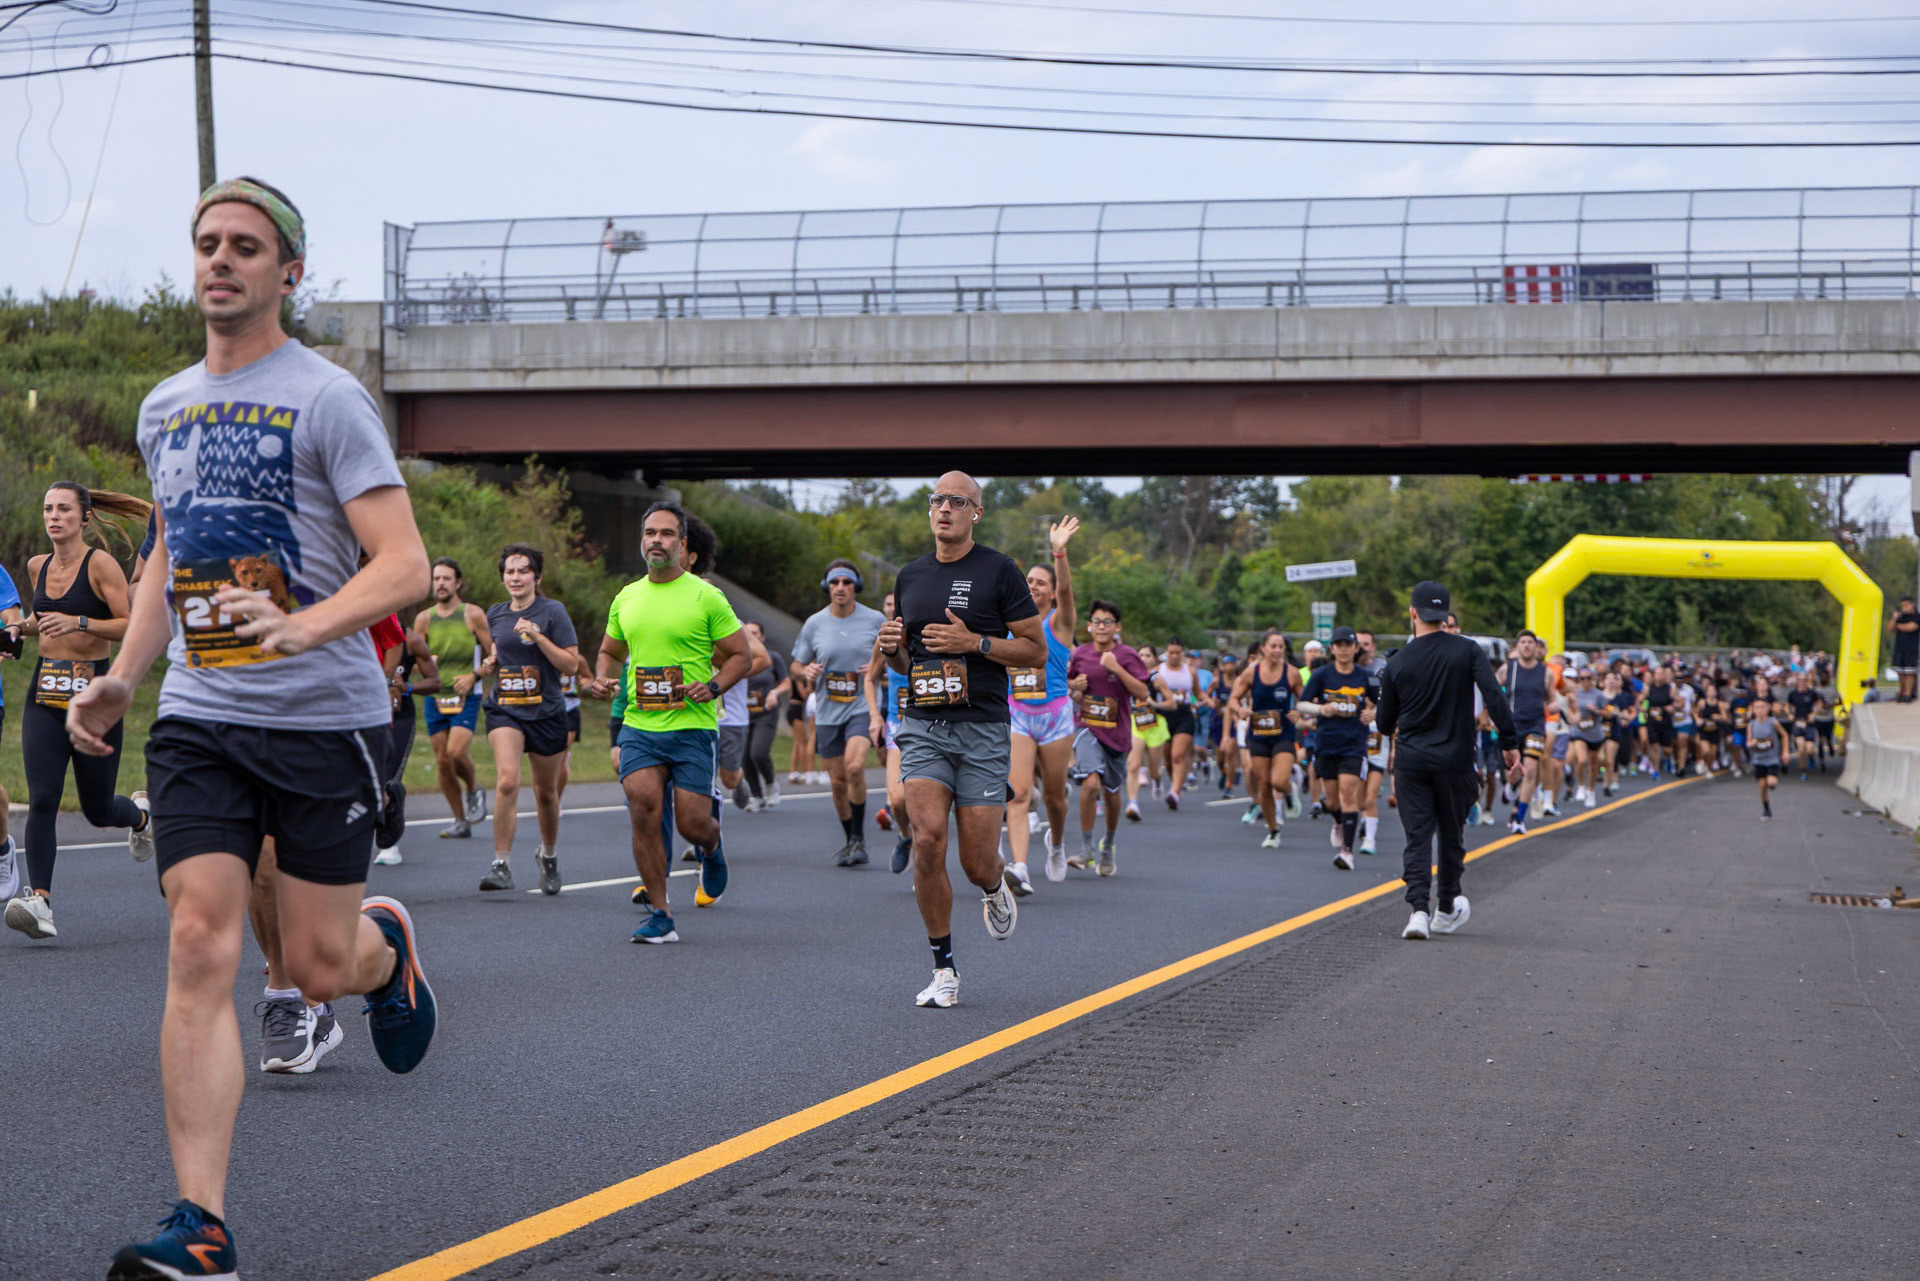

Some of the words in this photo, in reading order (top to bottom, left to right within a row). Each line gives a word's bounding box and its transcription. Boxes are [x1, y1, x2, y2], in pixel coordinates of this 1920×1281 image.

[174, 568, 192, 577] THE
[174, 582, 212, 590] CHASE
[41, 675, 89, 692] 336
[501, 678, 537, 690] 329
[643, 681, 672, 695] 35
[915, 677, 962, 695] 335
[1089, 704, 1110, 716] 37
